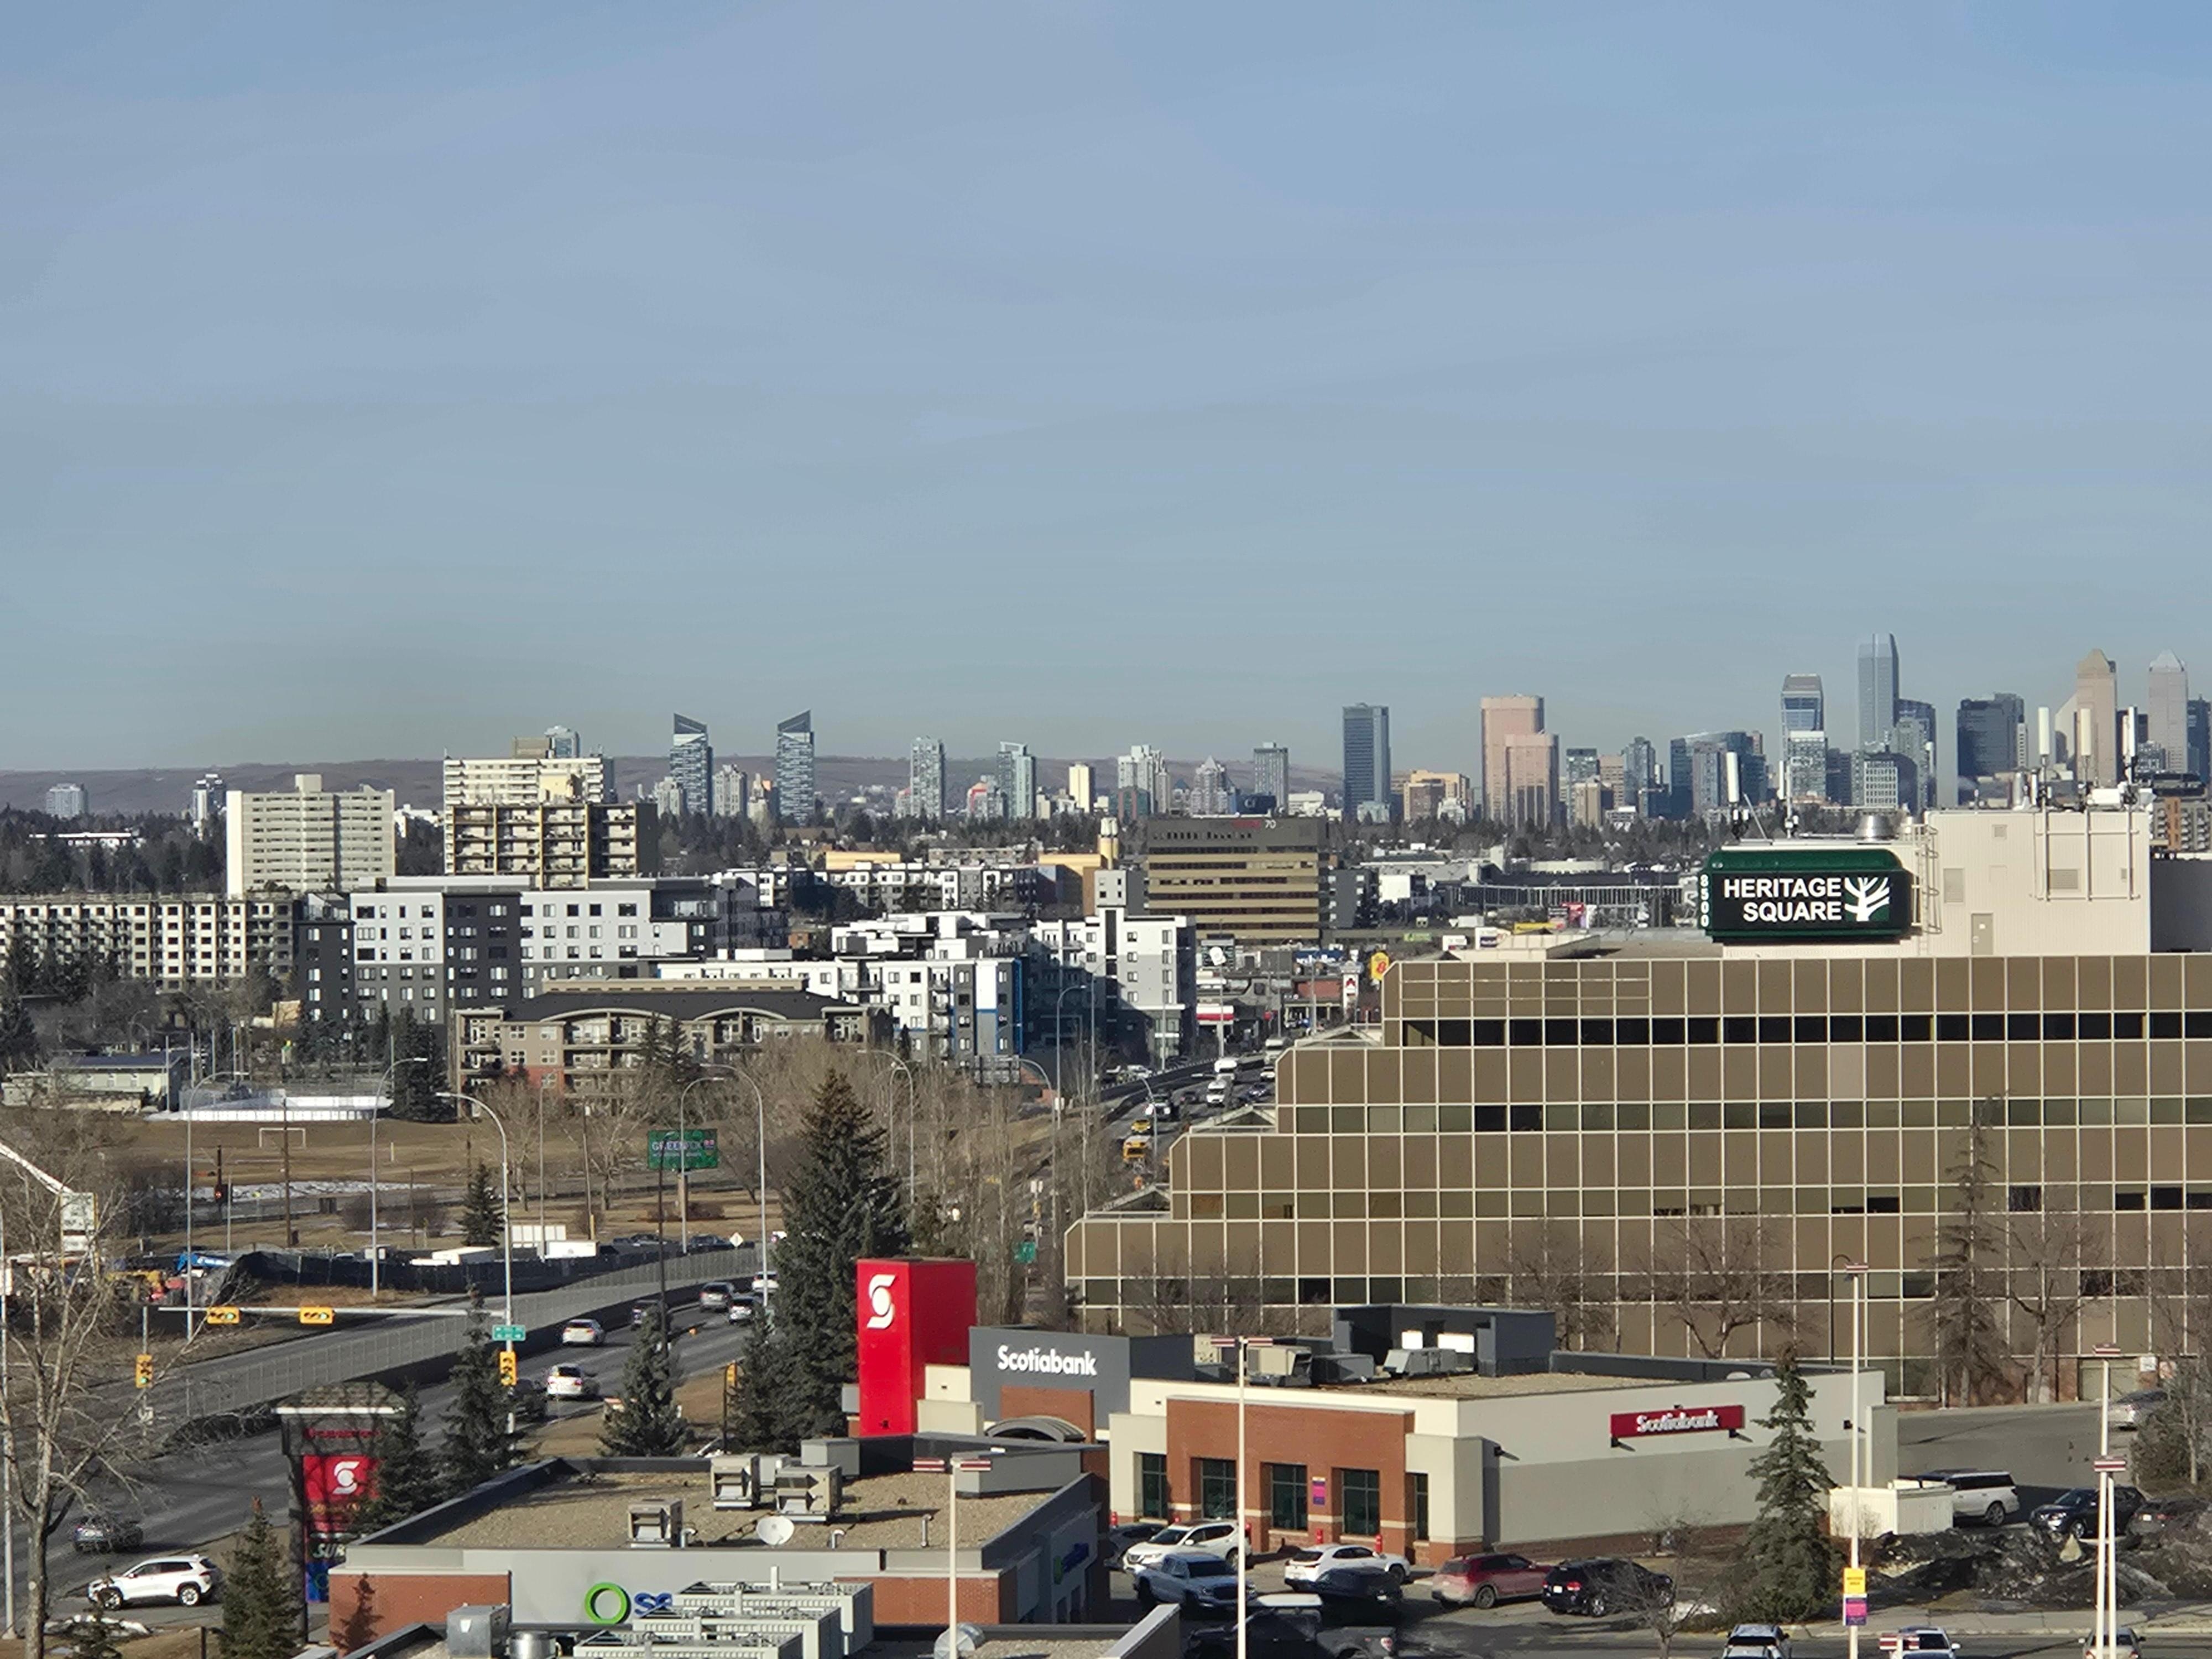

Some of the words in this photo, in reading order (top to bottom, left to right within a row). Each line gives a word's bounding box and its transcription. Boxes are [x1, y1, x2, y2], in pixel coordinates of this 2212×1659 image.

[1724, 878, 1842, 898] HERITAGE
[1700, 874, 1710, 927] 8500
[1743, 901, 1842, 922] SQUARE
[997, 1345, 1097, 1376] Scotiabank
[1636, 1410, 1719, 1432] Scotiabank
